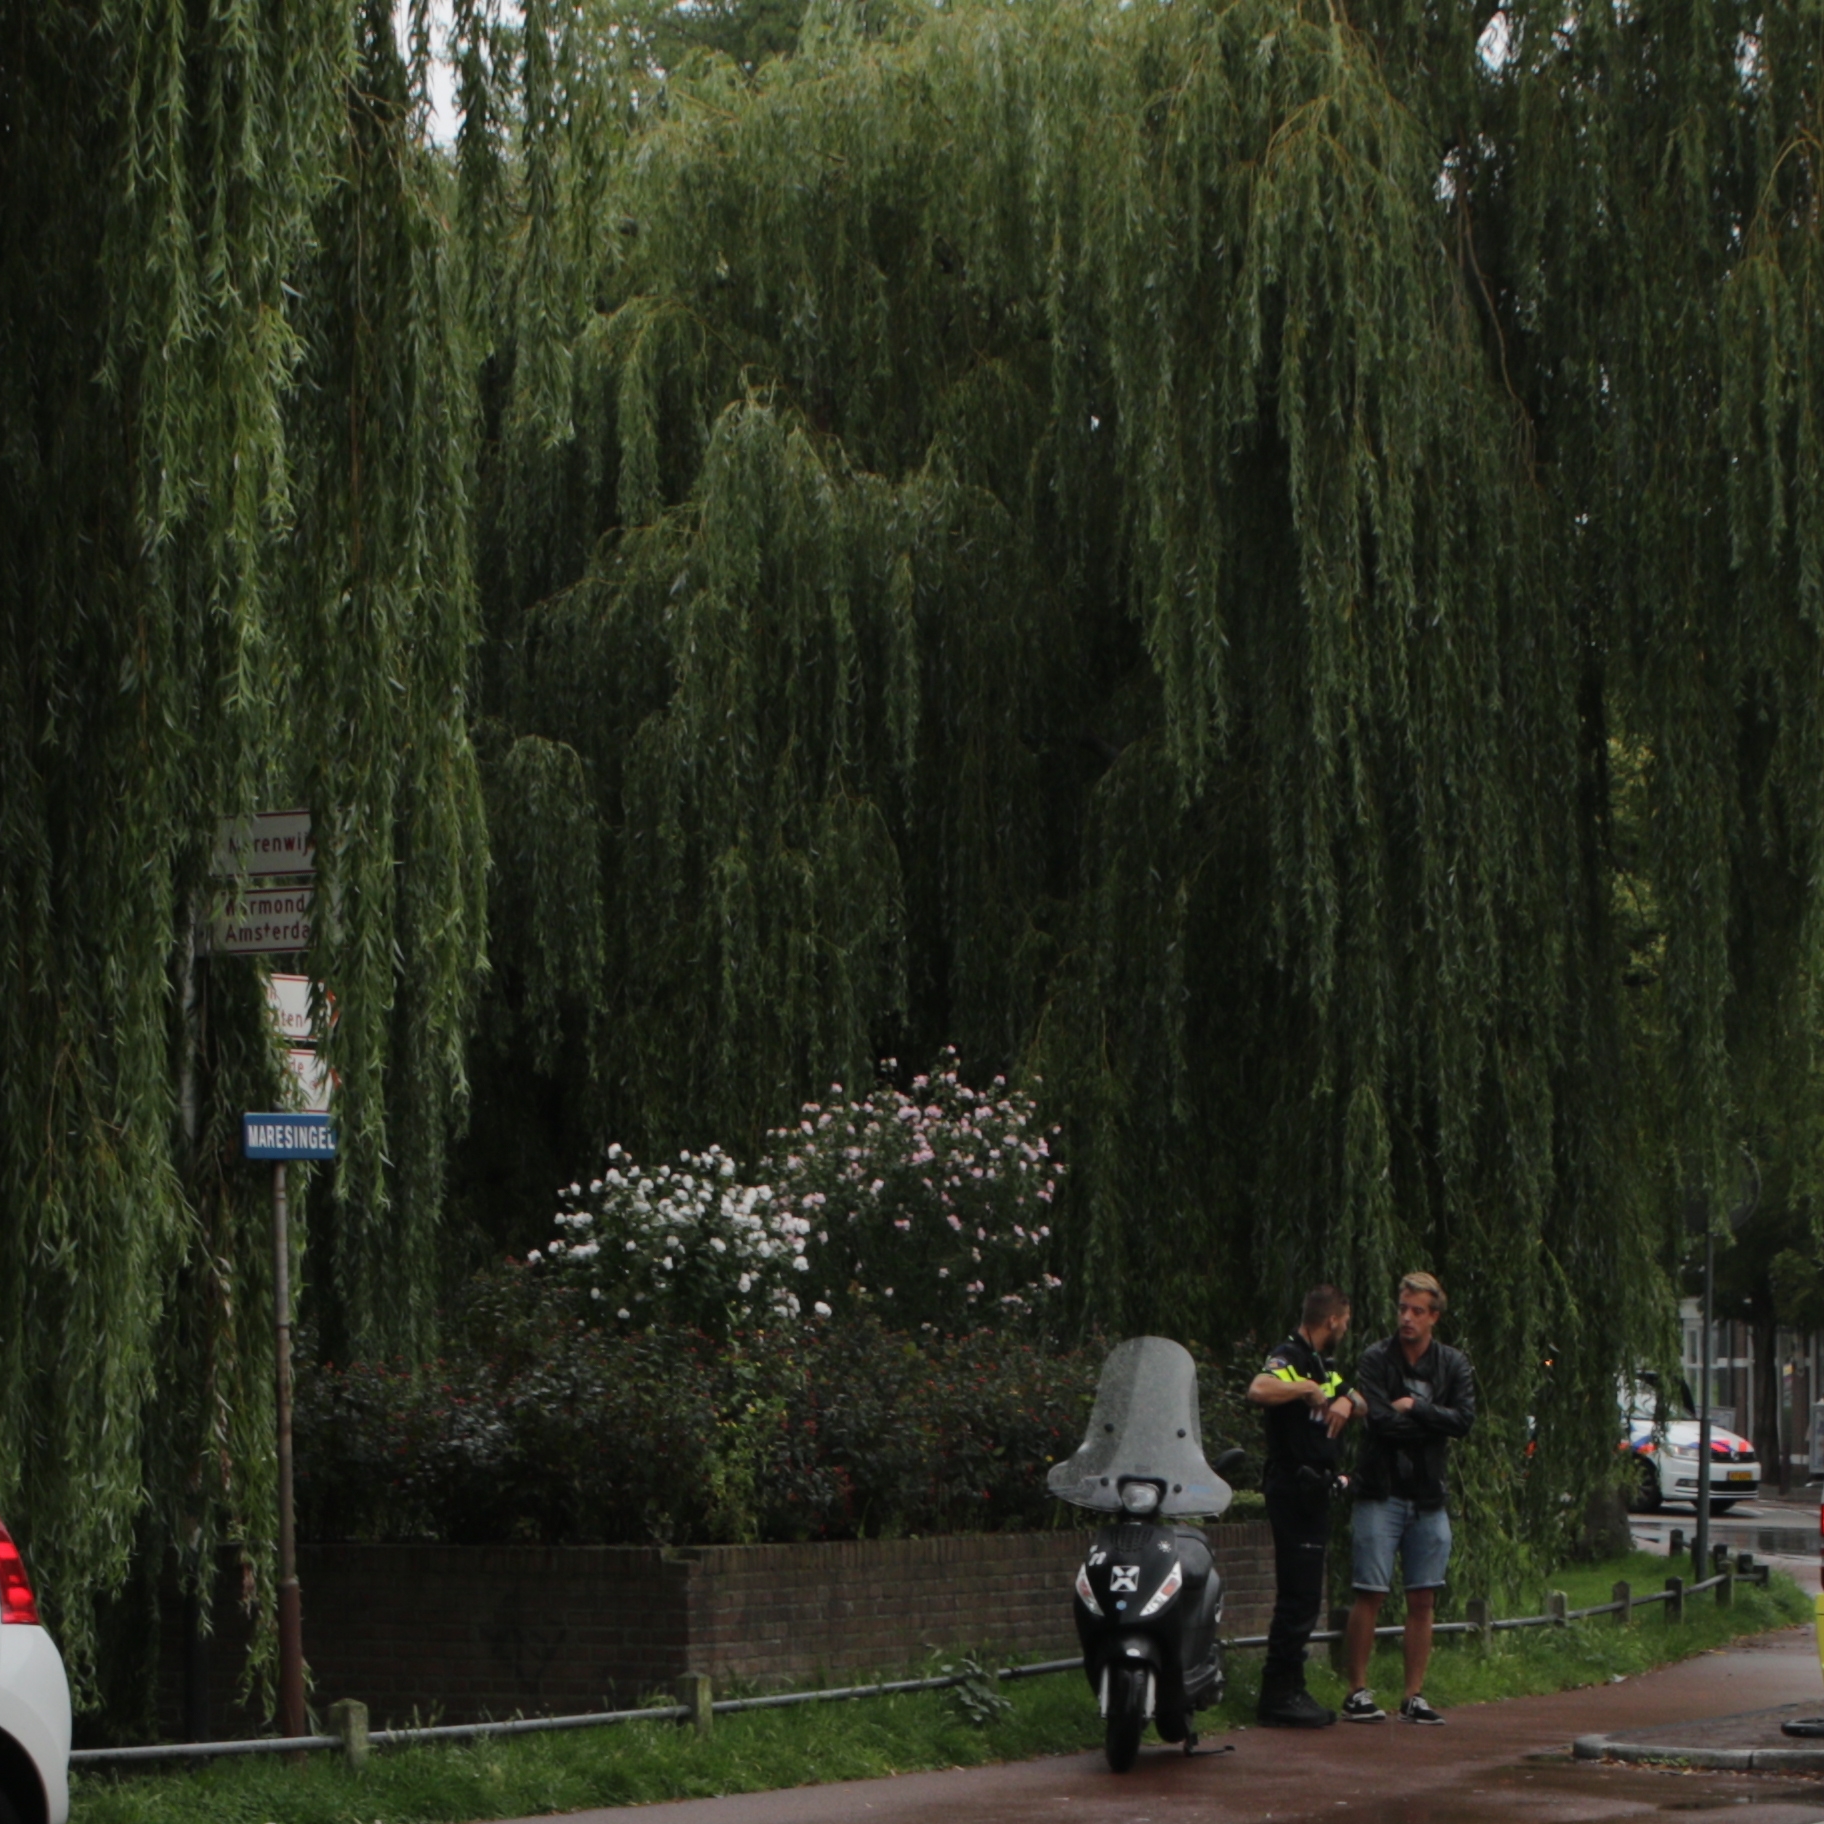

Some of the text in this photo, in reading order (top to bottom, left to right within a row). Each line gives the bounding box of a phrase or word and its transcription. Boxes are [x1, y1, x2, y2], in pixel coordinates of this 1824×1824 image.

[228, 831, 316, 857] Mrenwij
[225, 921, 311, 943] Amsterda
[248, 1124, 336, 1150] MARESINGEL
